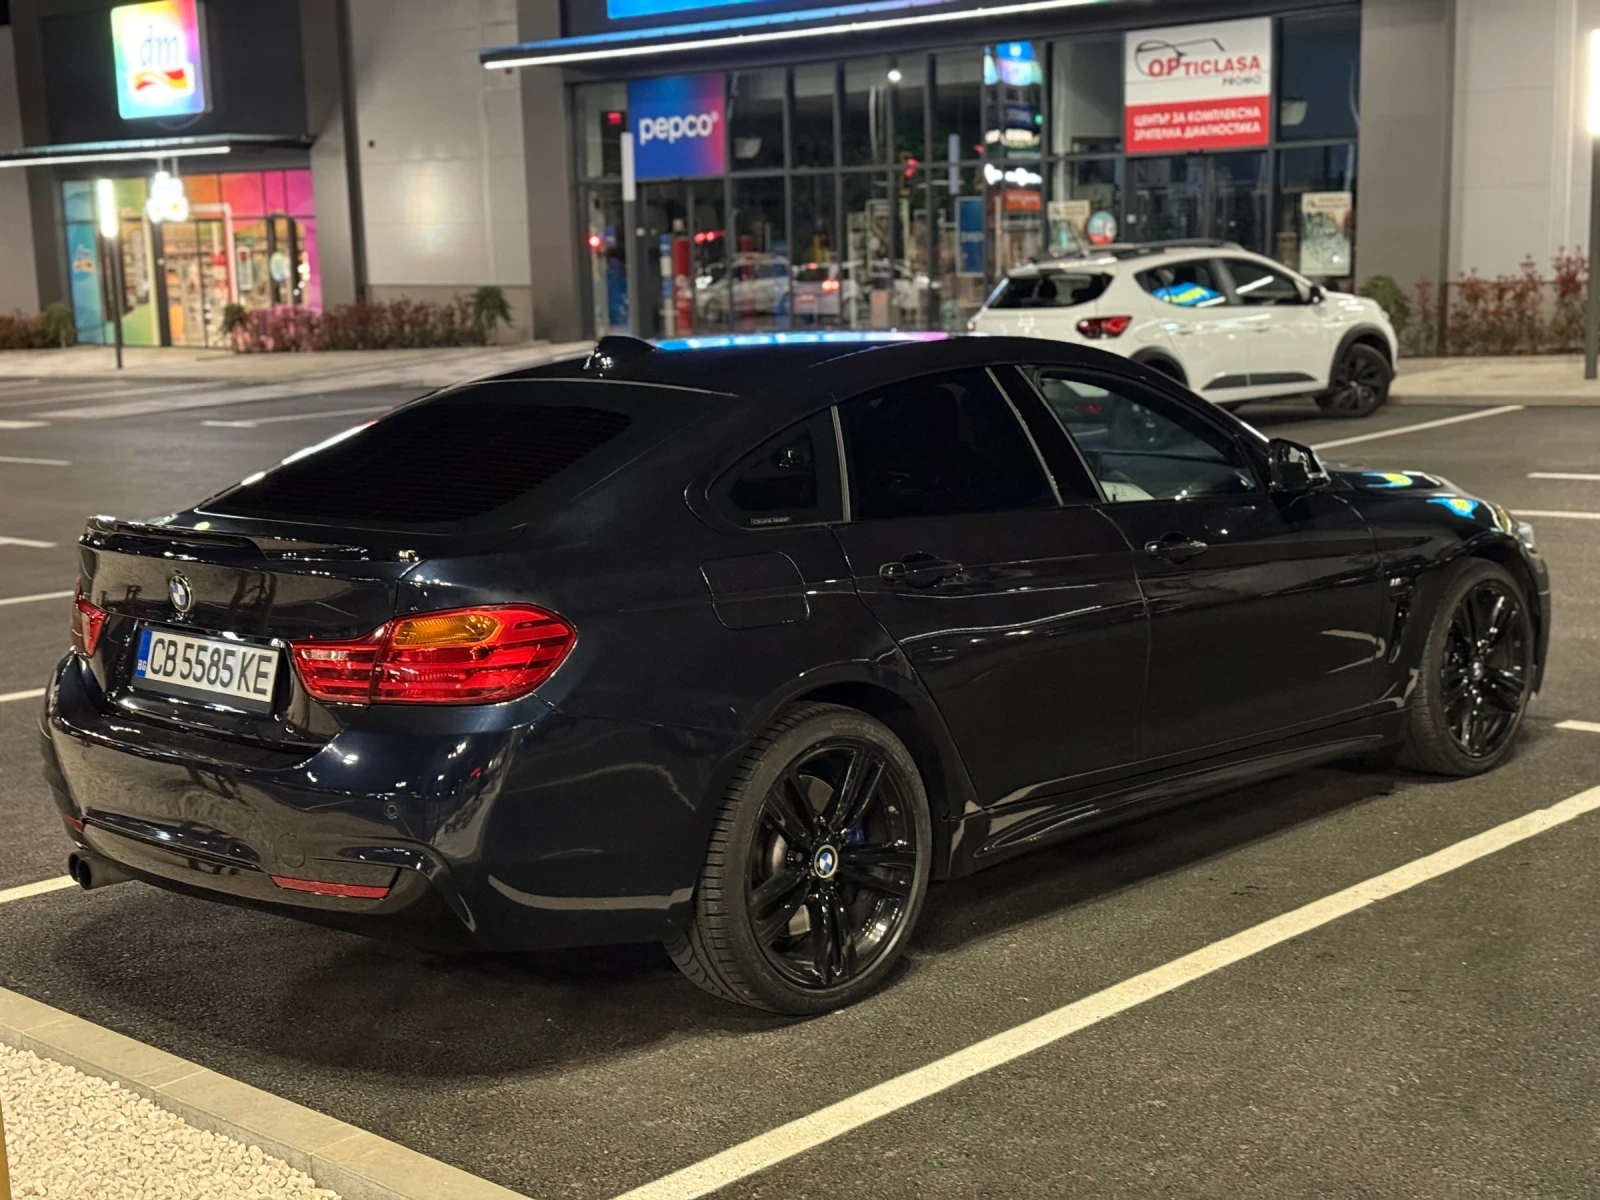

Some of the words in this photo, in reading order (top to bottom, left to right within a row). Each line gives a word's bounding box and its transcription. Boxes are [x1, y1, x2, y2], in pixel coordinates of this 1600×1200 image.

[140, 24, 179, 68] dm
[1148, 55, 1261, 77] OPTICLASA
[1222, 75, 1262, 86] PROMO
[639, 112, 714, 146] pepco
